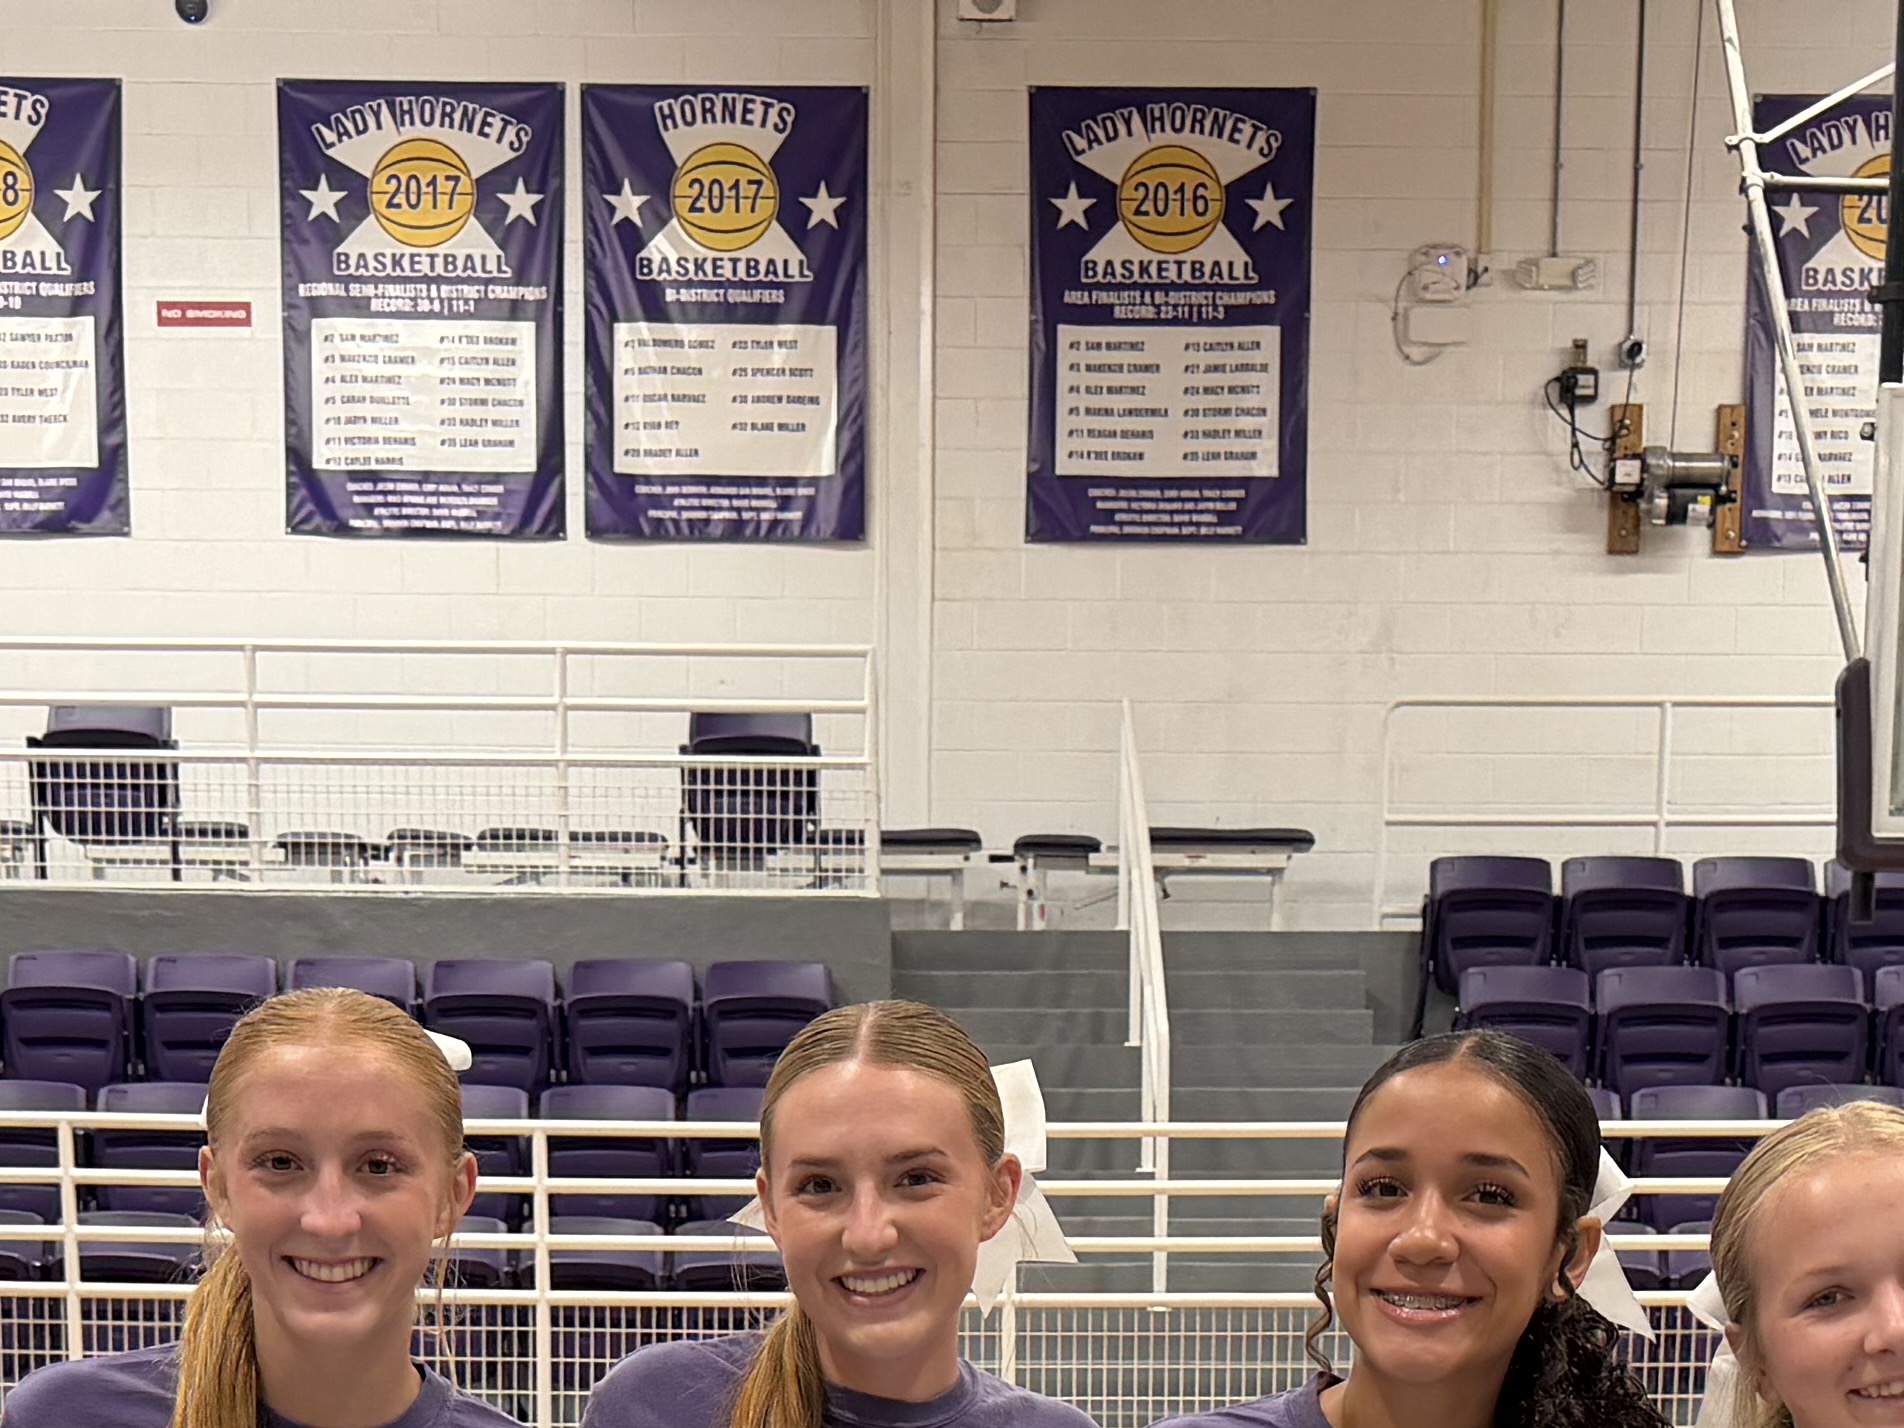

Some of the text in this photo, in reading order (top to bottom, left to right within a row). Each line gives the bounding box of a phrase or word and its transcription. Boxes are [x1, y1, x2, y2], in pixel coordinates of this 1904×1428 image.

[312, 97, 531, 153] LADY HORNETS
[658, 96, 793, 135] HORNETS
[1064, 105, 1281, 159] LADY HORNETS
[1788, 115, 1858, 166] LADY
[385, 173, 463, 210] 2017
[687, 178, 764, 214] 2017
[1132, 181, 1209, 218] 2016
[335, 252, 512, 275] BASKETBALL
[638, 256, 813, 279] BASKETBALL
[1083, 259, 1259, 282] BASKETBALL
